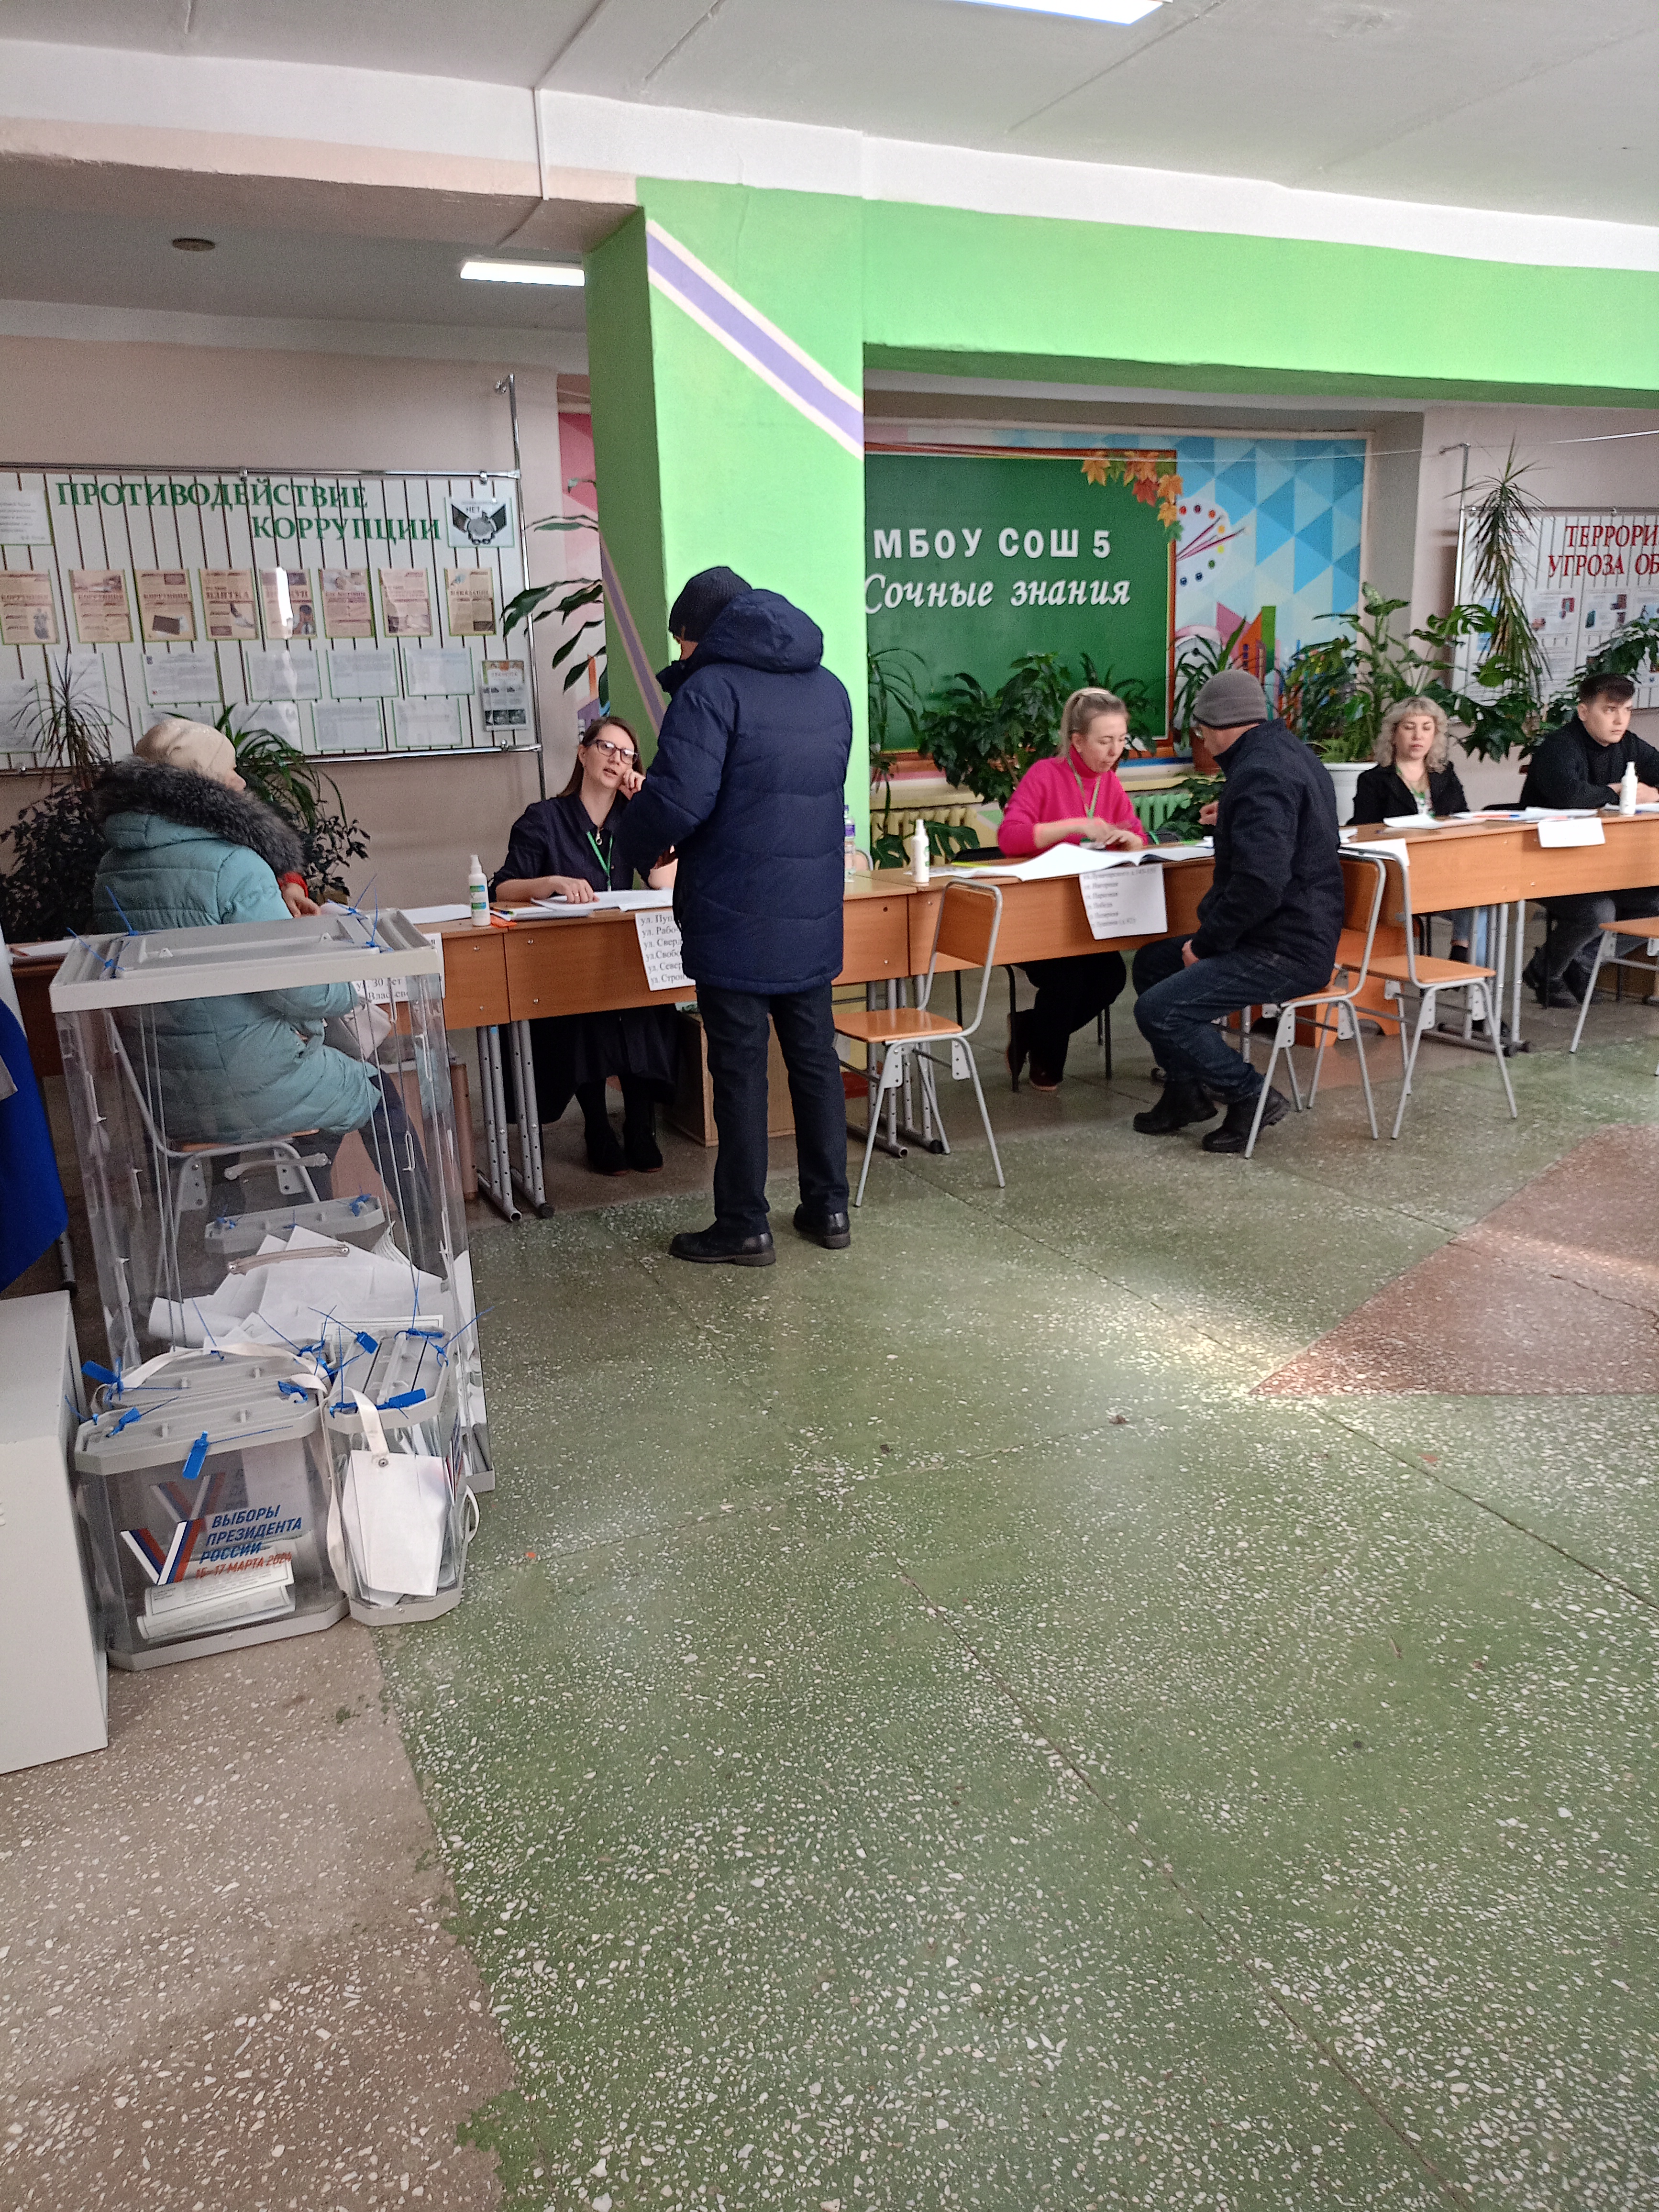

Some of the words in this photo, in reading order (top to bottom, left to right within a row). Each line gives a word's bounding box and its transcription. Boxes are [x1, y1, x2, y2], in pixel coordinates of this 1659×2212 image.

[56, 479, 368, 510] ПРОТИВОДЕЙСТВИЕ
[253, 516, 442, 545] КОРРУПЦИИ
[873, 528, 983, 559] МБОУ
[998, 528, 1079, 558] СОШ
[1092, 530, 1111, 558] 5
[1548, 553, 1625, 578] УГРОЗА
[864, 573, 995, 614] Сочные
[1010, 579, 1131, 606] знания
[640, 917, 653, 926] ул.
[642, 929, 654, 938] ул.
[643, 941, 655, 951] ул.
[648, 965, 659, 974] ул.
[373, 977, 384, 987] 30
[211, 1504, 281, 1529] ВЫБОРЫ
[205, 1517, 302, 1547] ПРЕЗИДЕНТА
[199, 1541, 263, 1565] РОССИИ
[227, 1556, 264, 1574] МАРТА
